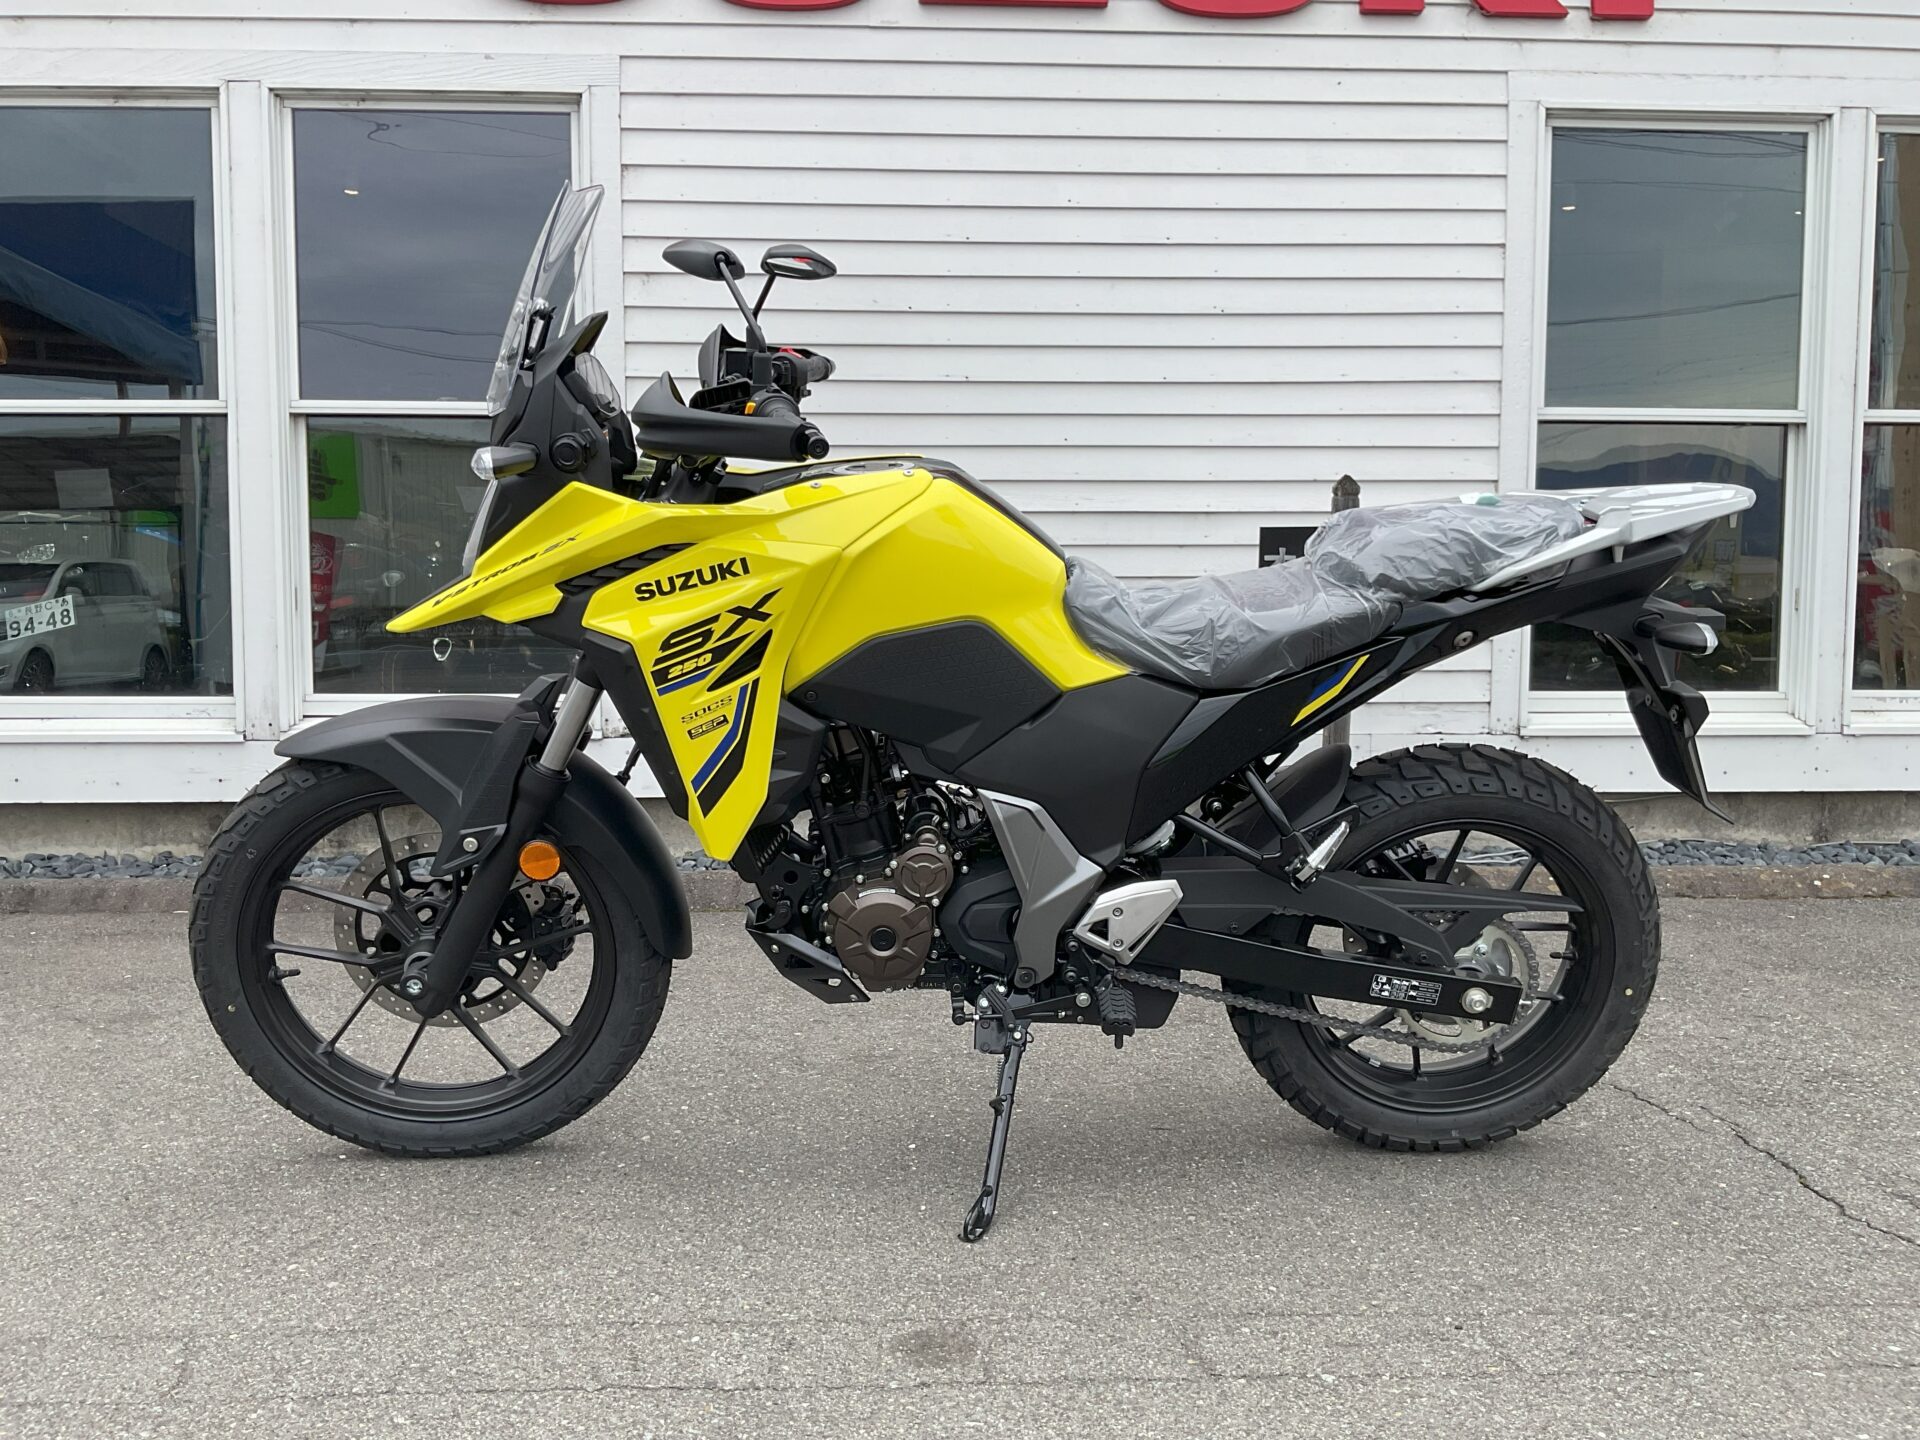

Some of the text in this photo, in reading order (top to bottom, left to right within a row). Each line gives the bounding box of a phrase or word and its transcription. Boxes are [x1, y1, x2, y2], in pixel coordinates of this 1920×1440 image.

[634, 557, 751, 602] SUZUKI
[9, 608, 72, 638] 94-48
[652, 587, 784, 669] SX
[667, 653, 713, 679] 250
[690, 716, 725, 737] SEP
